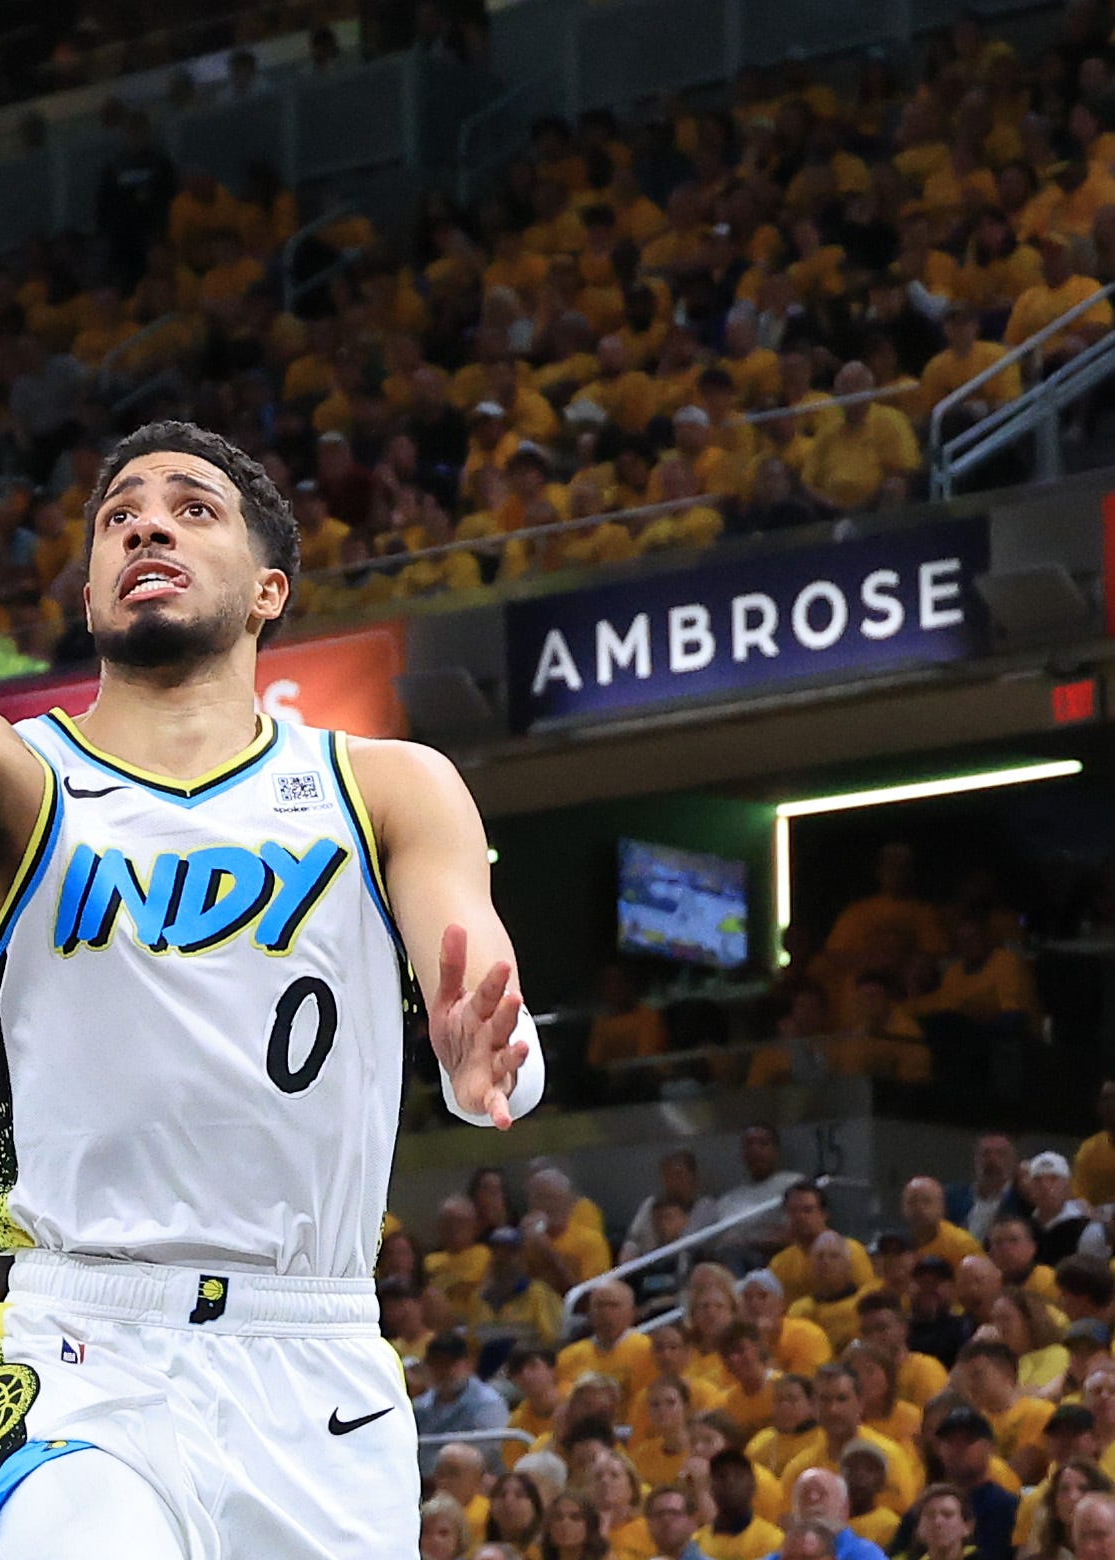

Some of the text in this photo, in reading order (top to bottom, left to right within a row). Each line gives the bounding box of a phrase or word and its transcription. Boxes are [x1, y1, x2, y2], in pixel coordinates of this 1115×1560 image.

[532, 557, 965, 695] AMBROSE
[53, 837, 351, 958] INDY
[266, 975, 338, 1094] 0
